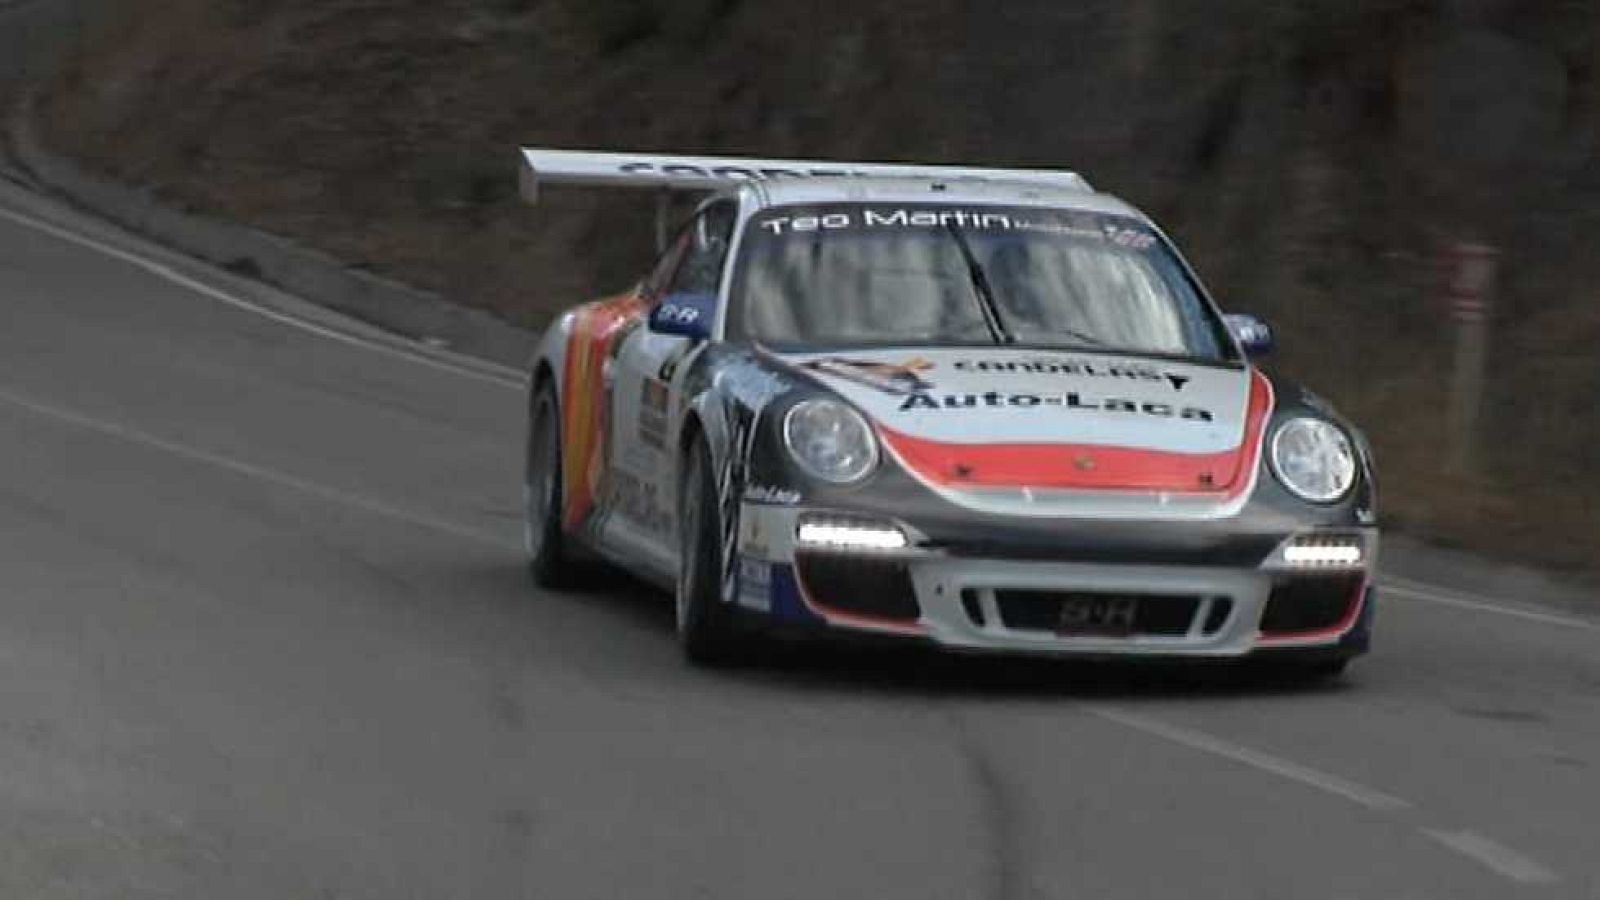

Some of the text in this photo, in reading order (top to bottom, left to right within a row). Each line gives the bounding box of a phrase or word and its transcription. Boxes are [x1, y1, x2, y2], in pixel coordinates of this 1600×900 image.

[761, 213, 850, 235] Teo
[863, 209, 1010, 229] Martin
[899, 391, 1213, 422] Auto-Laca
